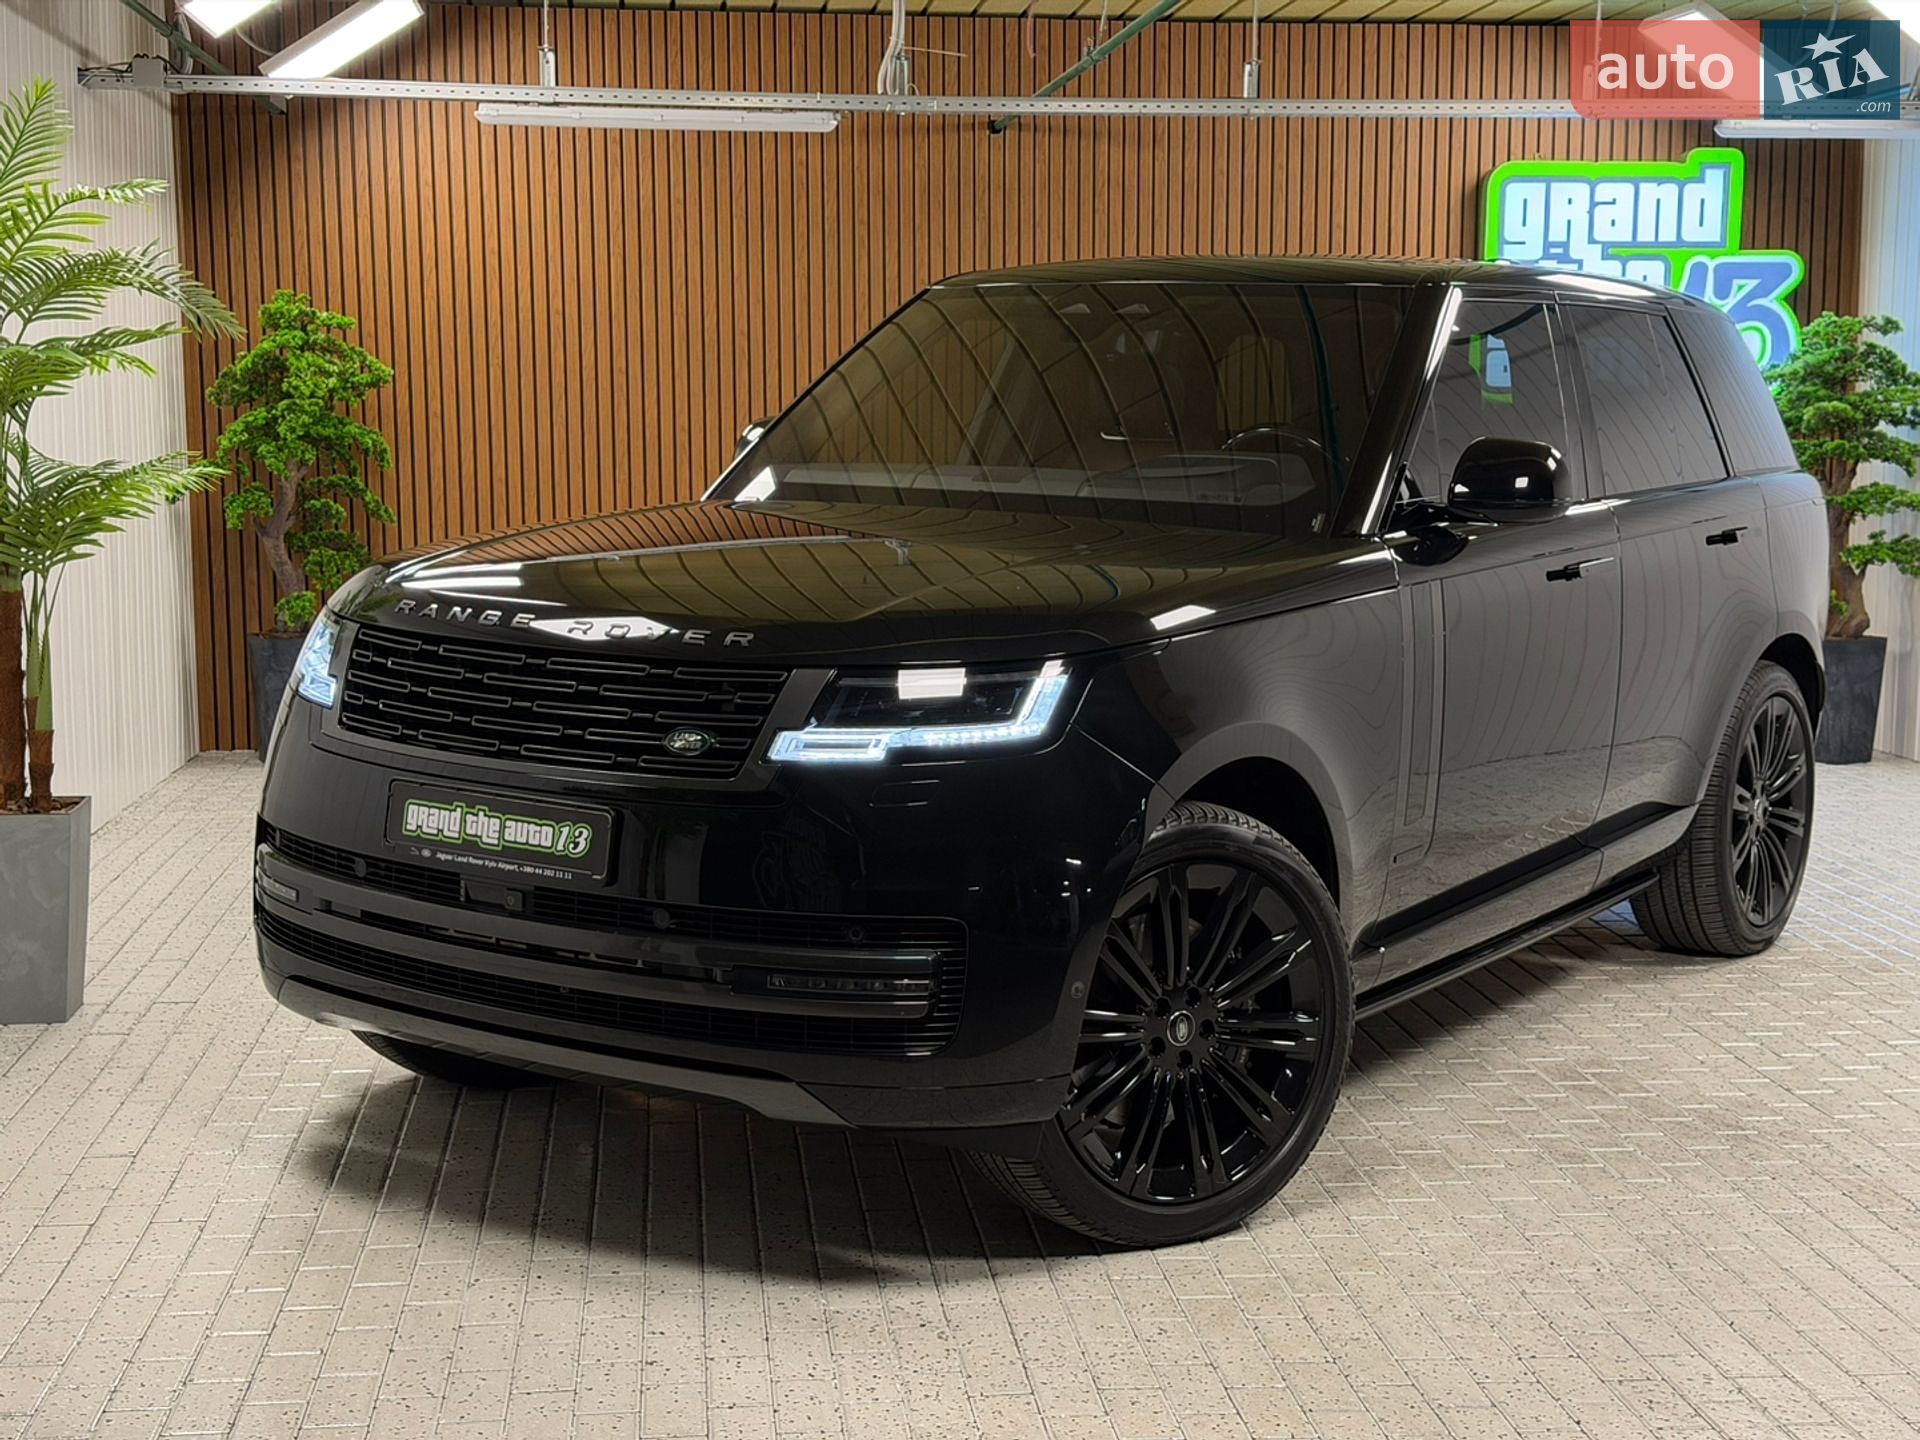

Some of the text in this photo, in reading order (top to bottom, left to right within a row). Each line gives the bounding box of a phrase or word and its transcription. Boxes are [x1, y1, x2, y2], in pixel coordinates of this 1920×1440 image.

[394, 599, 756, 648] RANGE ROVER
[503, 820, 554, 847] auto
[557, 825, 588, 853] 13
[435, 851, 453, 861] Jaguar
[469, 856, 484, 866] Rover
